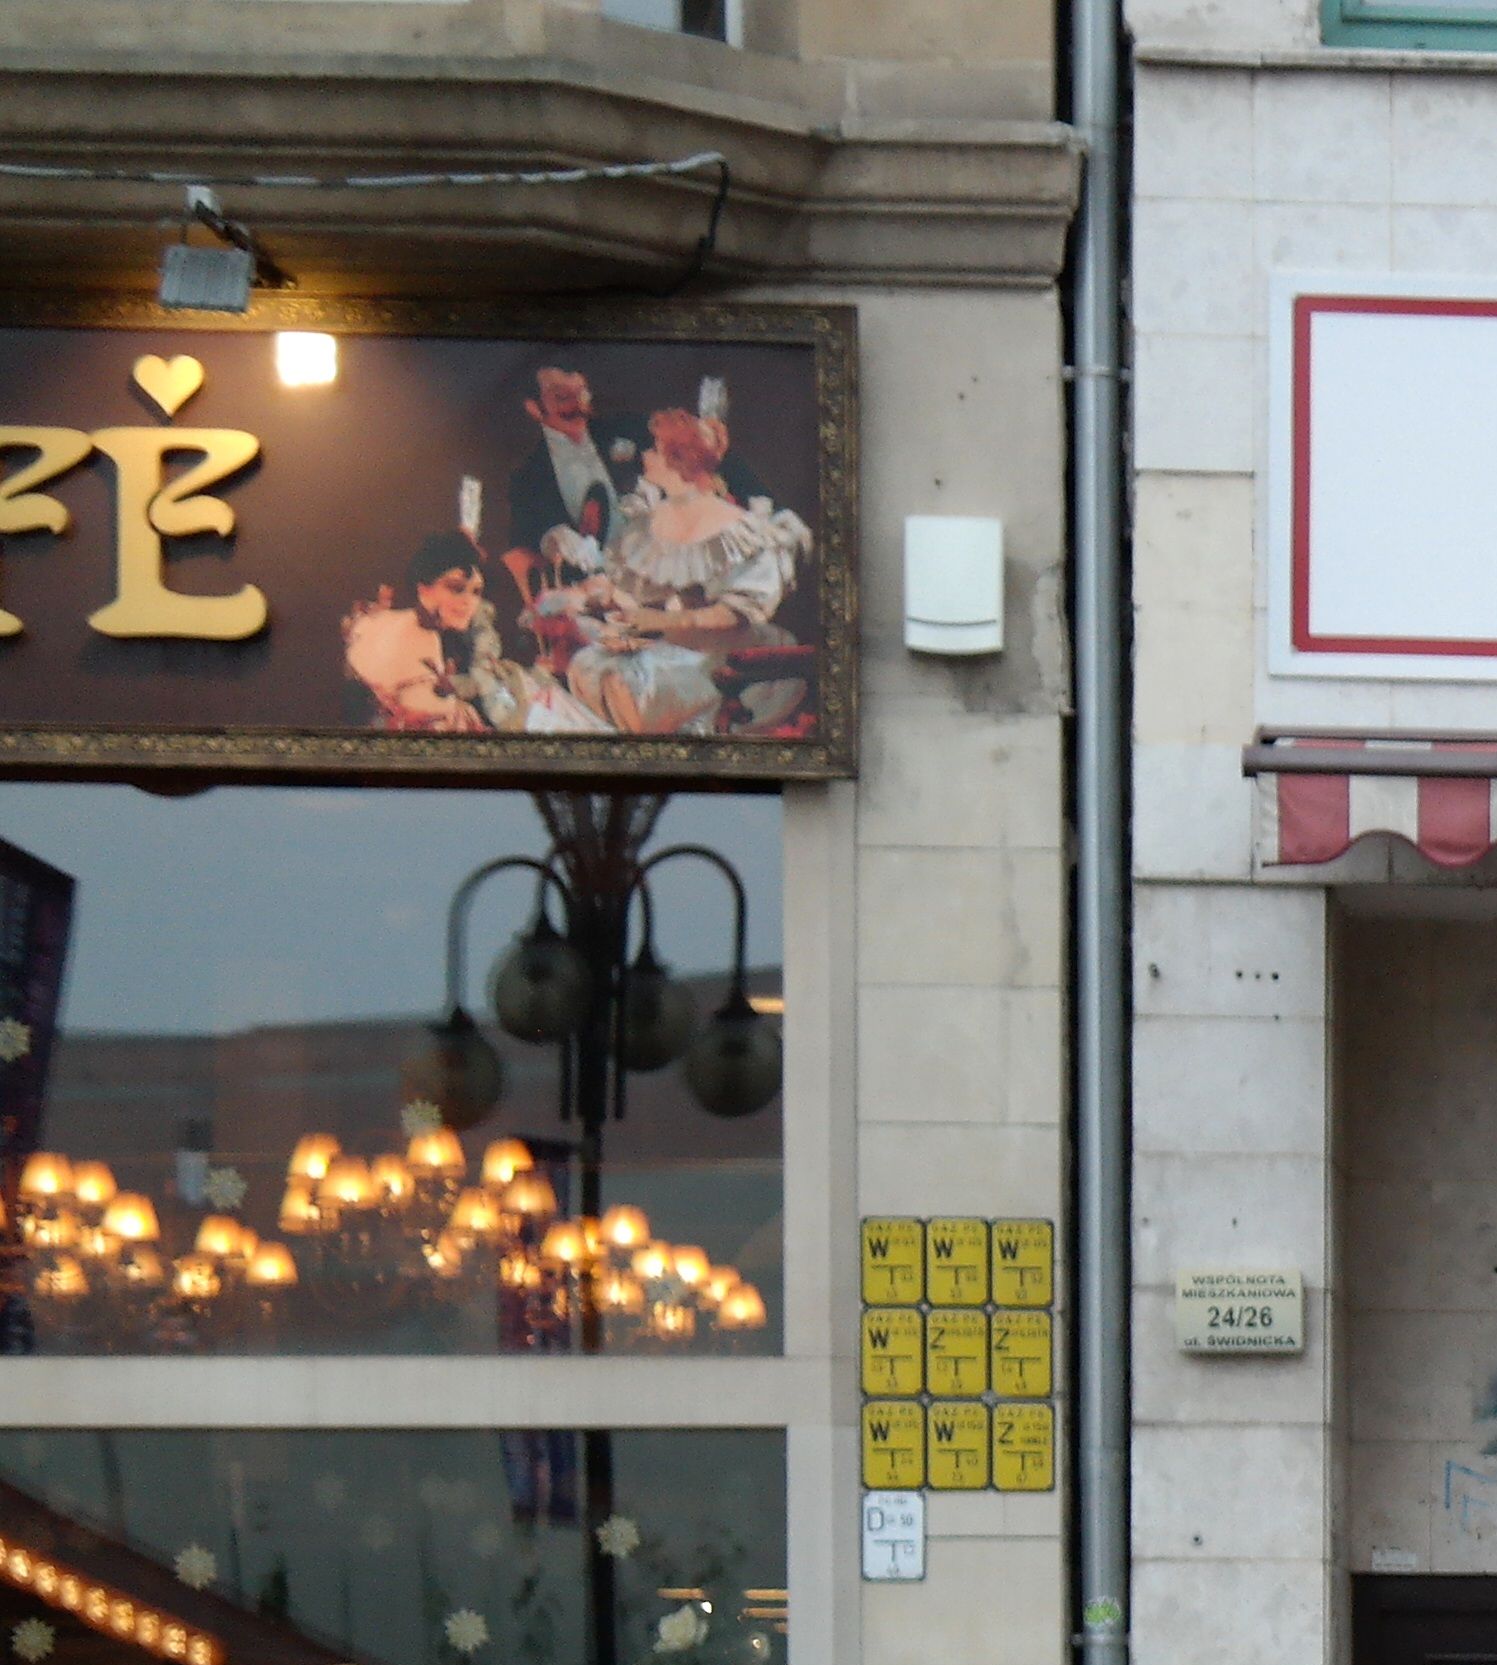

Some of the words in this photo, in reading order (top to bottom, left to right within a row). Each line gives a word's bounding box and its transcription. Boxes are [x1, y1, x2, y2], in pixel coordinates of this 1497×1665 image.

[869, 1238, 888, 1259] W
[934, 1239, 953, 1259] W
[998, 1239, 1018, 1260] W
[1182, 1289, 1296, 1298] MIESZKANIOWA
[1208, 1306, 1273, 1328] 24/26
[868, 1328, 890, 1349] W
[929, 1326, 946, 1349] Z
[994, 1328, 1010, 1350] Z
[869, 1420, 890, 1442] W
[934, 1420, 954, 1442] W
[998, 1421, 1015, 1444] Z
[867, 1507, 884, 1531] D
